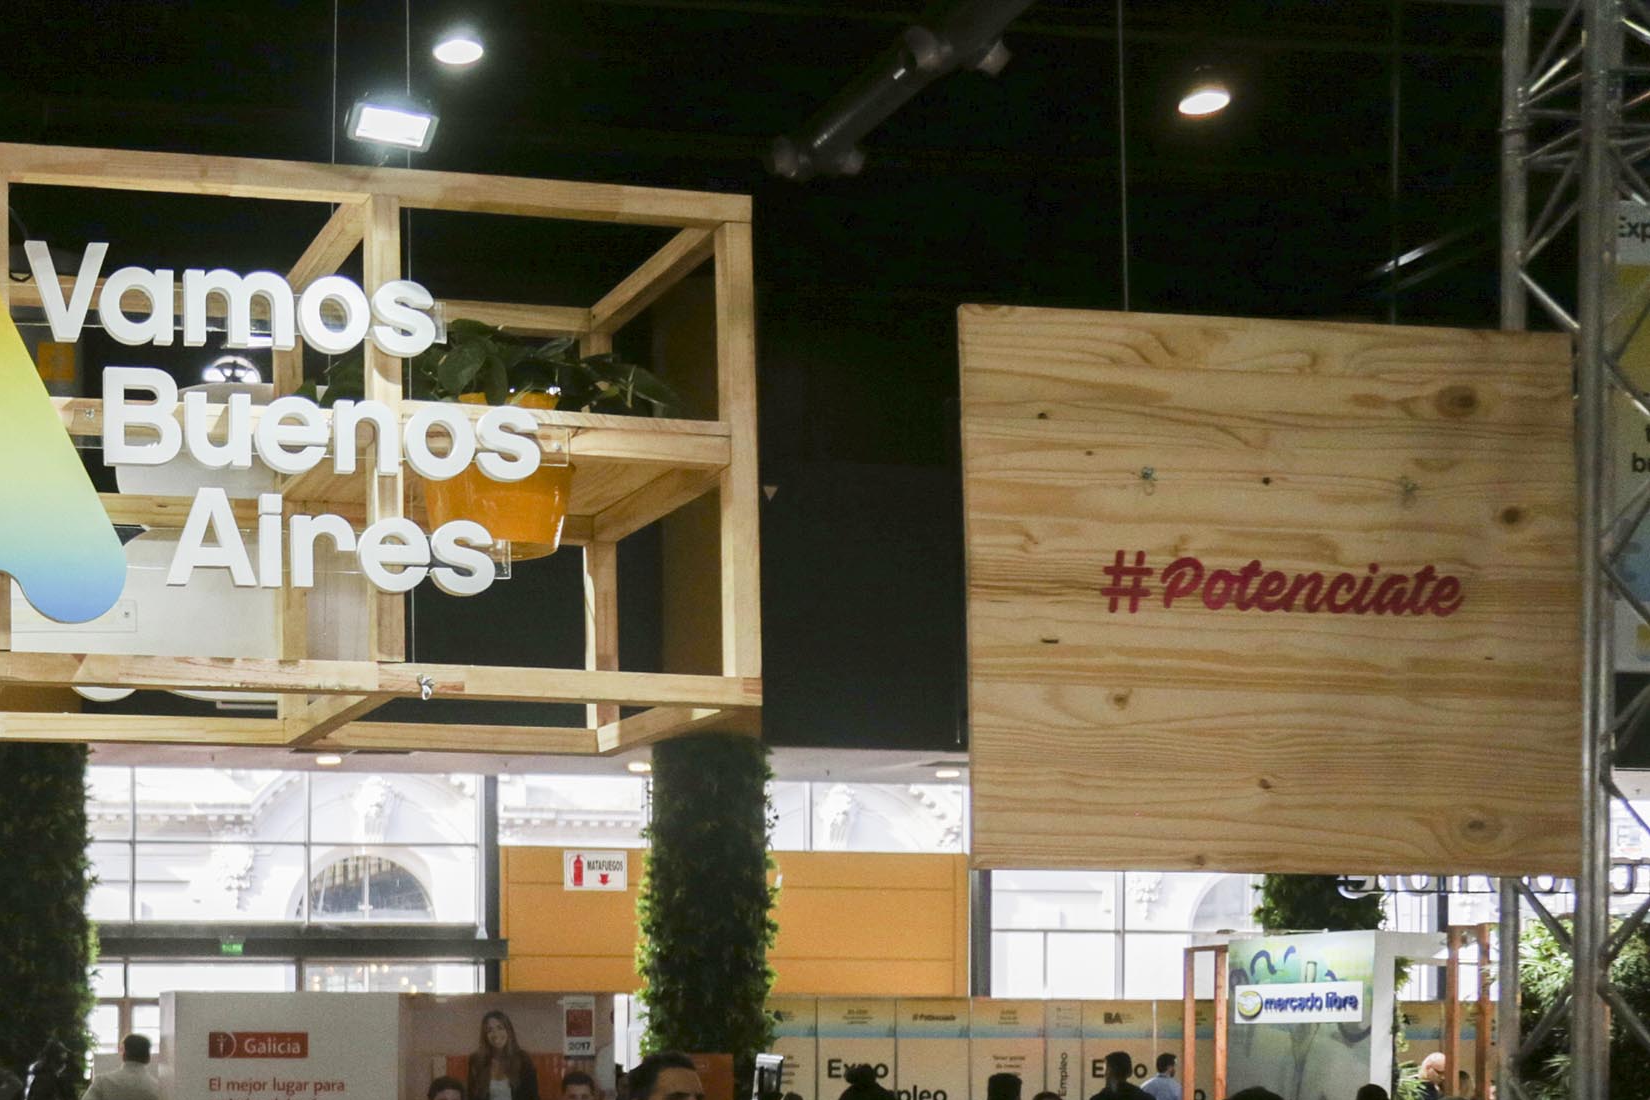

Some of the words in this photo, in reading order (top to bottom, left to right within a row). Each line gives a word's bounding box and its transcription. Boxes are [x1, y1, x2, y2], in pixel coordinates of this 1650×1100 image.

[24, 240, 437, 358] Vamos
[103, 366, 541, 482] Buenos
[166, 487, 496, 597] Aires
[1100, 550, 1465, 617] #Potenciate
[586, 859, 624, 872] MATAFUEGOS
[1264, 992, 1323, 1012] mercado
[1325, 991, 1359, 1009] libre
[1104, 1012, 1123, 1024] BA
[244, 1037, 301, 1054] Galicia
[567, 1041, 591, 1051] 2017
[1058, 1052, 1068, 1097] Empleo
[1092, 1059, 1147, 1079] Eo
[209, 1076, 221, 1091] El
[226, 1076, 268, 1094] mejor
[273, 1076, 309, 1096] lugar
[314, 1080, 346, 1095] para
